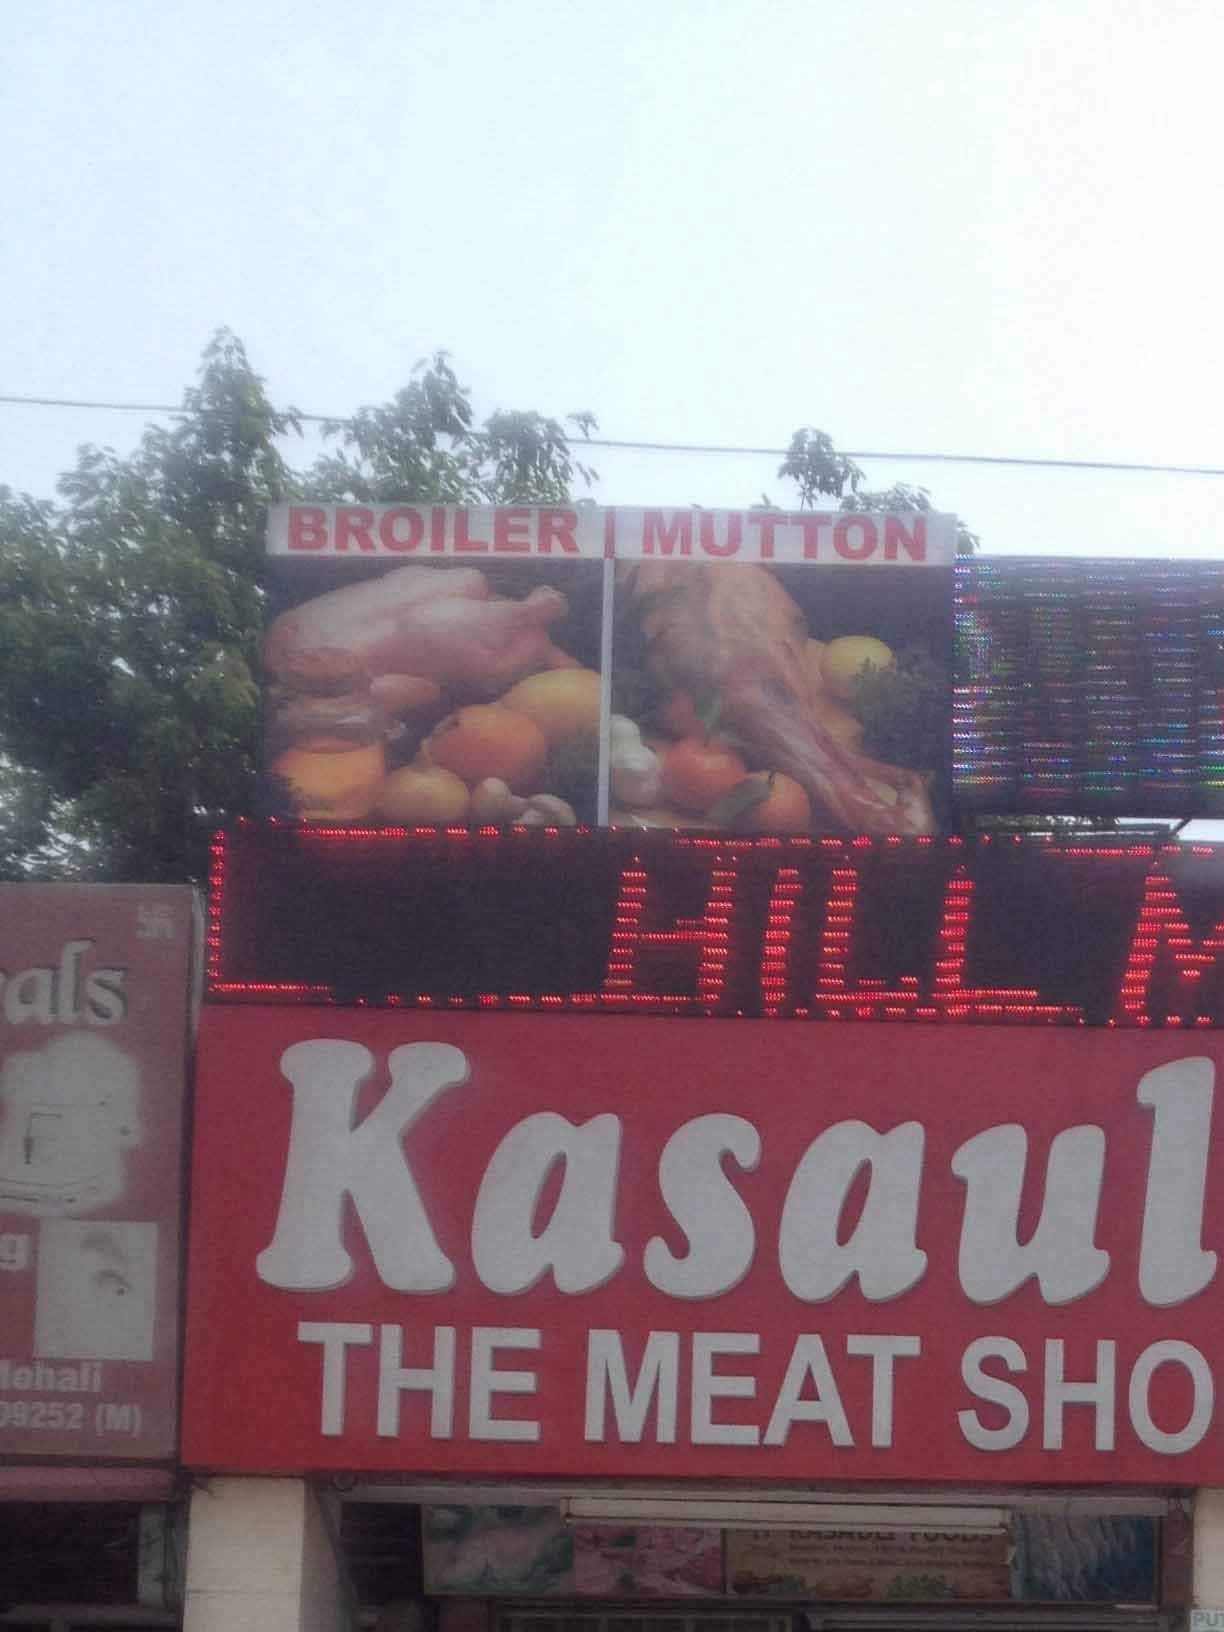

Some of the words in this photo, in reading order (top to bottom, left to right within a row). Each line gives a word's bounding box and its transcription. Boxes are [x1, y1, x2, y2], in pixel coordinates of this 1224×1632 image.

[287, 504, 581, 554] BROILER
[642, 510, 927, 561] MUTTON
[603, 857, 1075, 1015] HILL
[0, 938, 127, 1024] als
[298, 1321, 542, 1442] THE
[584, 1328, 921, 1448] MEAT
